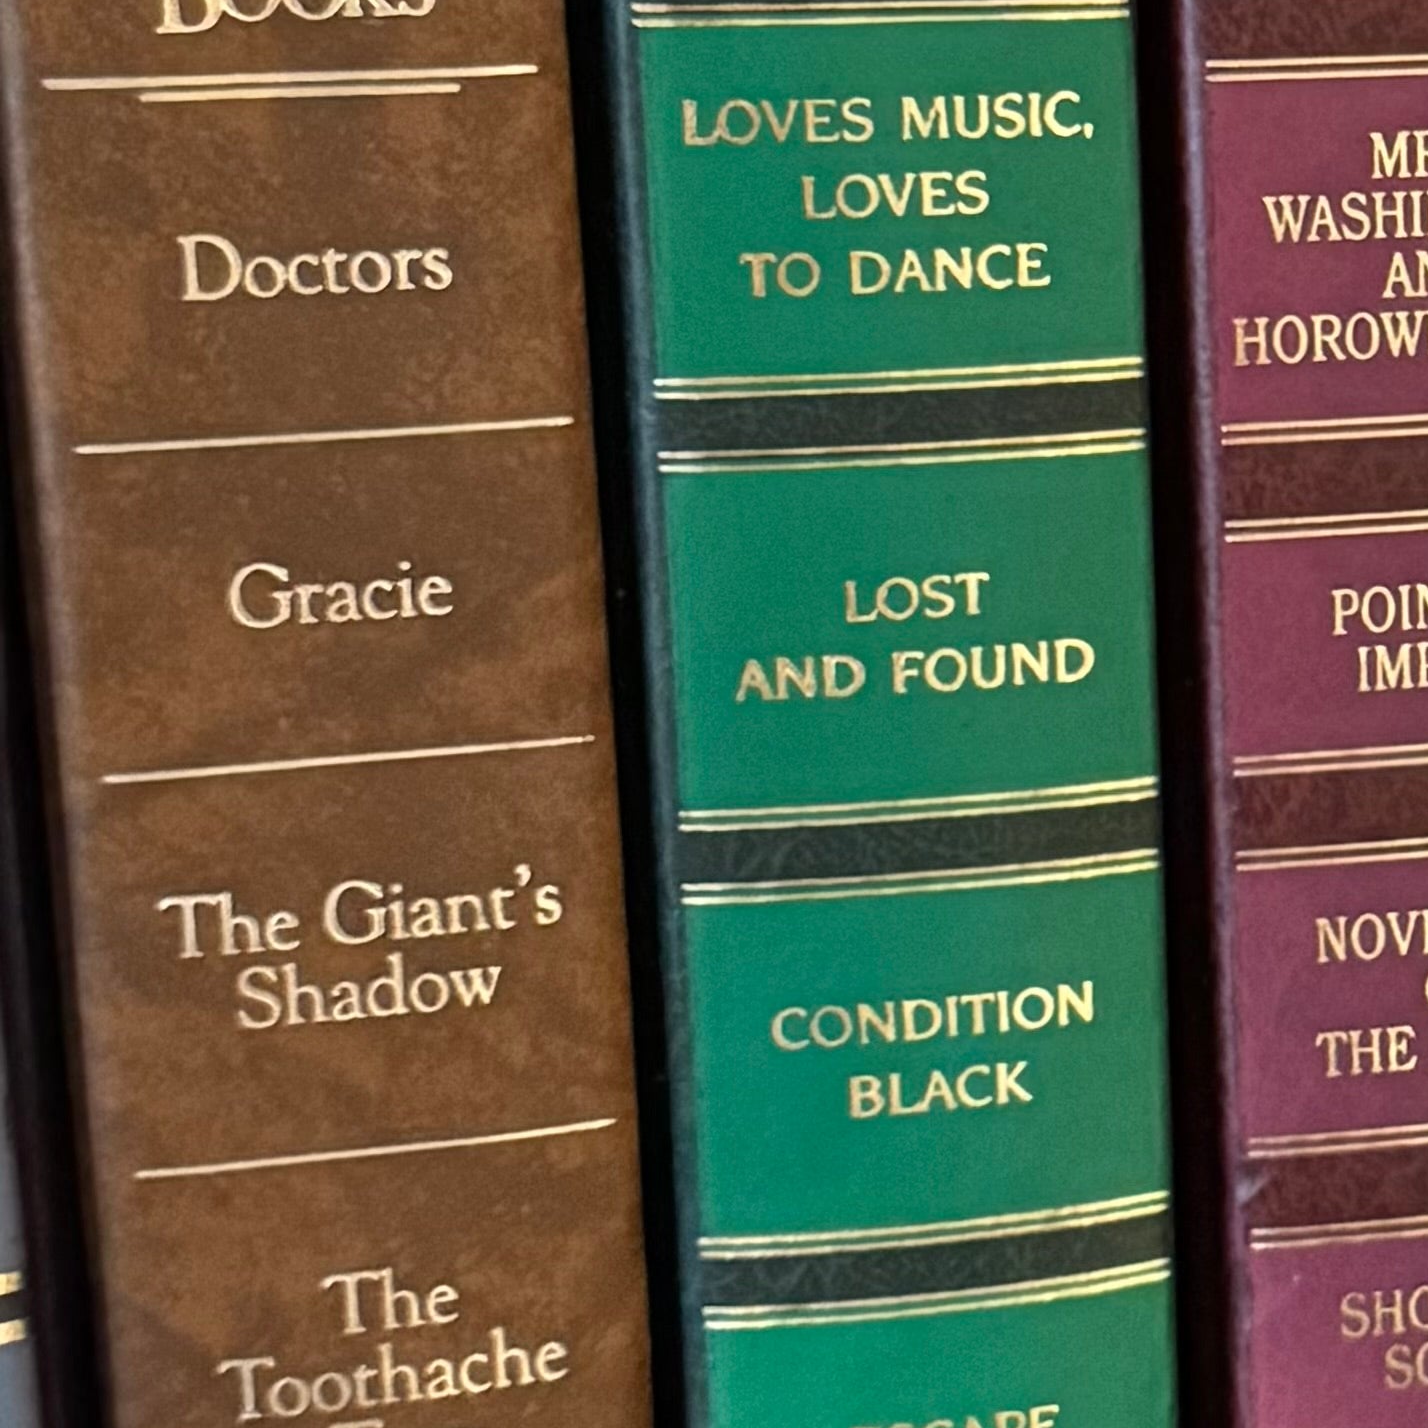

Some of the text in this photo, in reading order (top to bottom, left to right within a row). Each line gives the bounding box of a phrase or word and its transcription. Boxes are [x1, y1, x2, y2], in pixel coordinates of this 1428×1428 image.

[681, 89, 1094, 146] LOVES MUSIC,
[801, 170, 991, 220] LOVES
[177, 234, 454, 304] Doctors
[739, 242, 1053, 300] TO DANCE
[228, 562, 454, 629] Gracie
[843, 571, 990, 623] LOST
[735, 637, 1097, 703] AND FOUND
[156, 864, 564, 960] The Giant's
[237, 954, 502, 1030] Shadow
[770, 980, 1096, 1051] CONDITION
[1315, 1025, 1418, 1078] THE
[848, 1060, 1034, 1120] BLACK
[321, 1267, 460, 1335] The
[216, 1328, 569, 1423] Toothache
